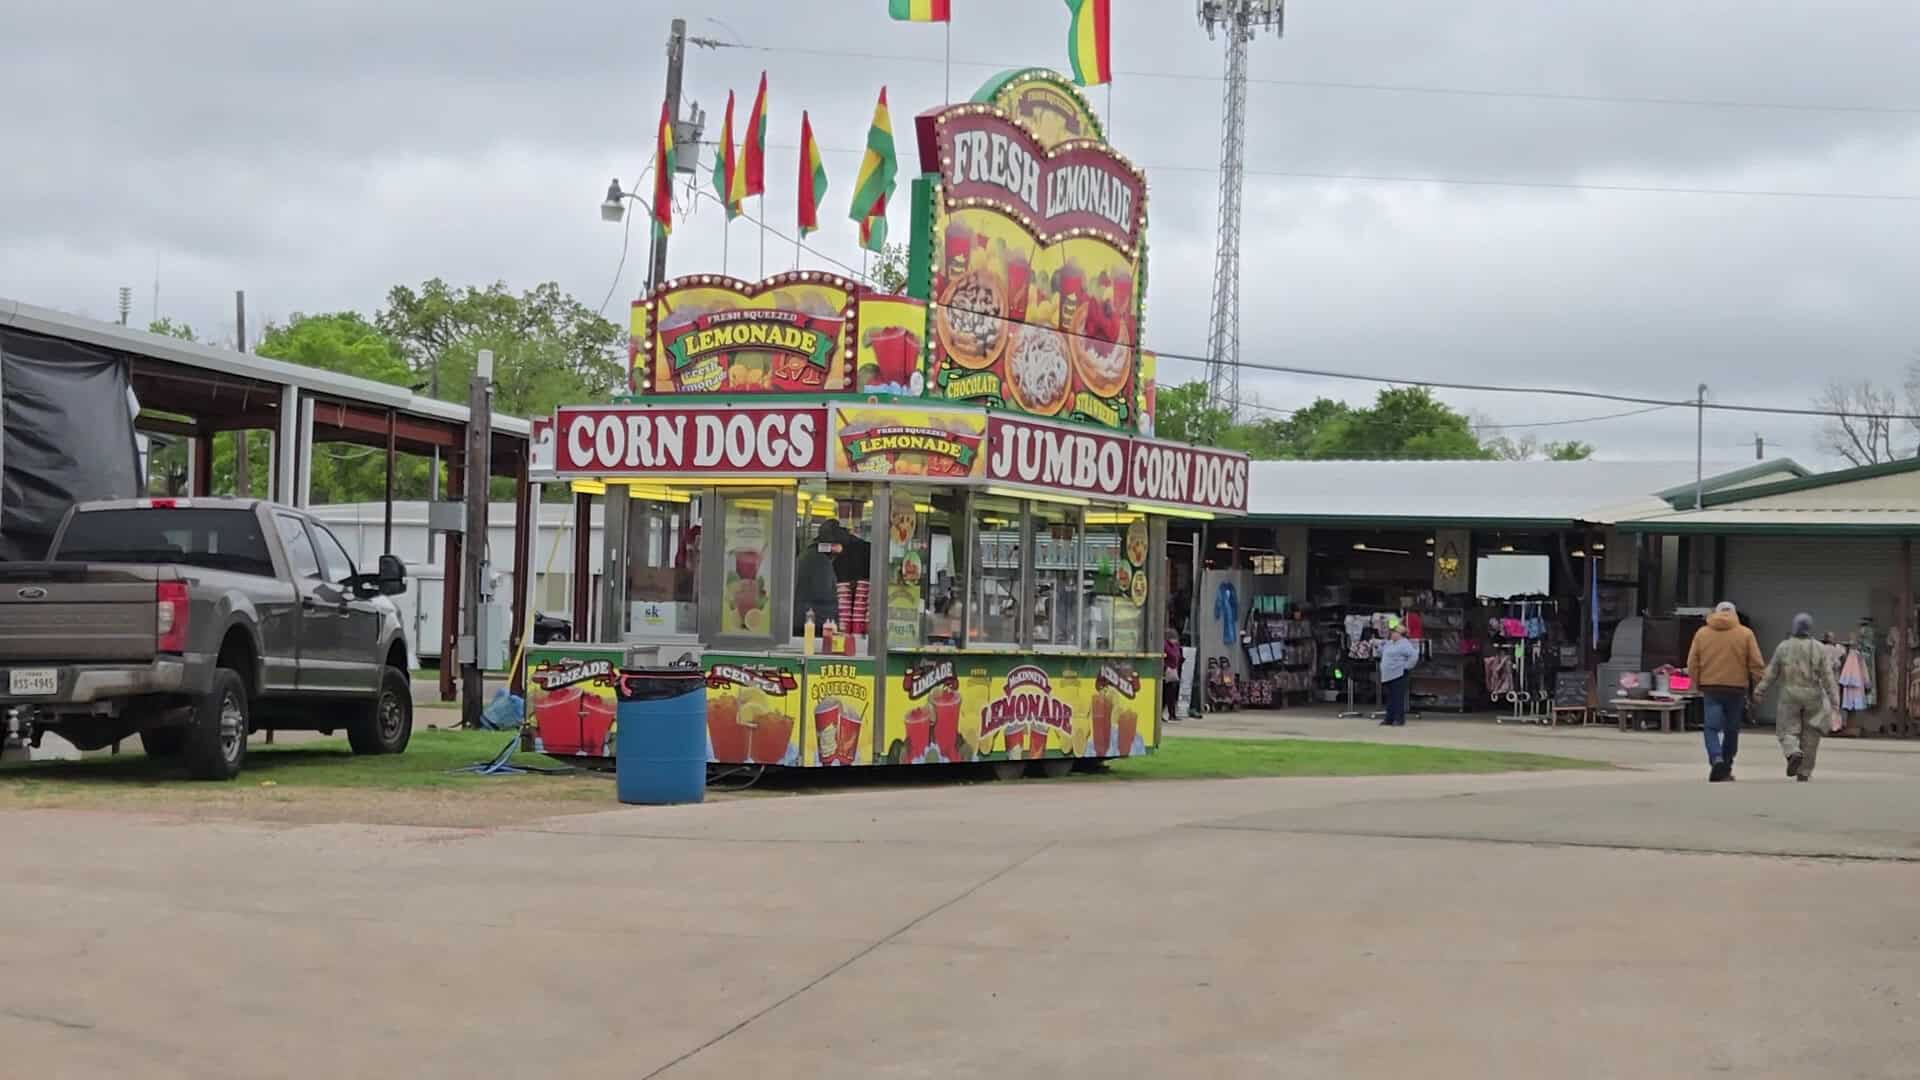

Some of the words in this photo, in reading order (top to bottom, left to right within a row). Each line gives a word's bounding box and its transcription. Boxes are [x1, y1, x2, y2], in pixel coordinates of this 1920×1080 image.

[953, 130, 1040, 213] FRESH
[1045, 165, 1131, 234] LEMONADE
[707, 312, 741, 324] FRESH
[743, 311, 798, 322] SQUEEZED
[685, 324, 817, 357] LEMONADE
[948, 373, 998, 398] CHOCOLATE
[568, 415, 687, 468] CORN
[693, 414, 815, 468] DOGS
[860, 436, 961, 456] LEMONADE
[992, 424, 1123, 492] JUMBO
[1133, 445, 1191, 501] CORN
[1193, 455, 1247, 508] DOGS
[547, 661, 609, 688] LIMEADE
[716, 666, 751, 685] ICED
[820, 664, 856, 679] FRESH
[912, 661, 953, 697] LIMEADE
[811, 680, 867, 700] SQUEEZED
[981, 694, 1073, 737] LEMONADE
